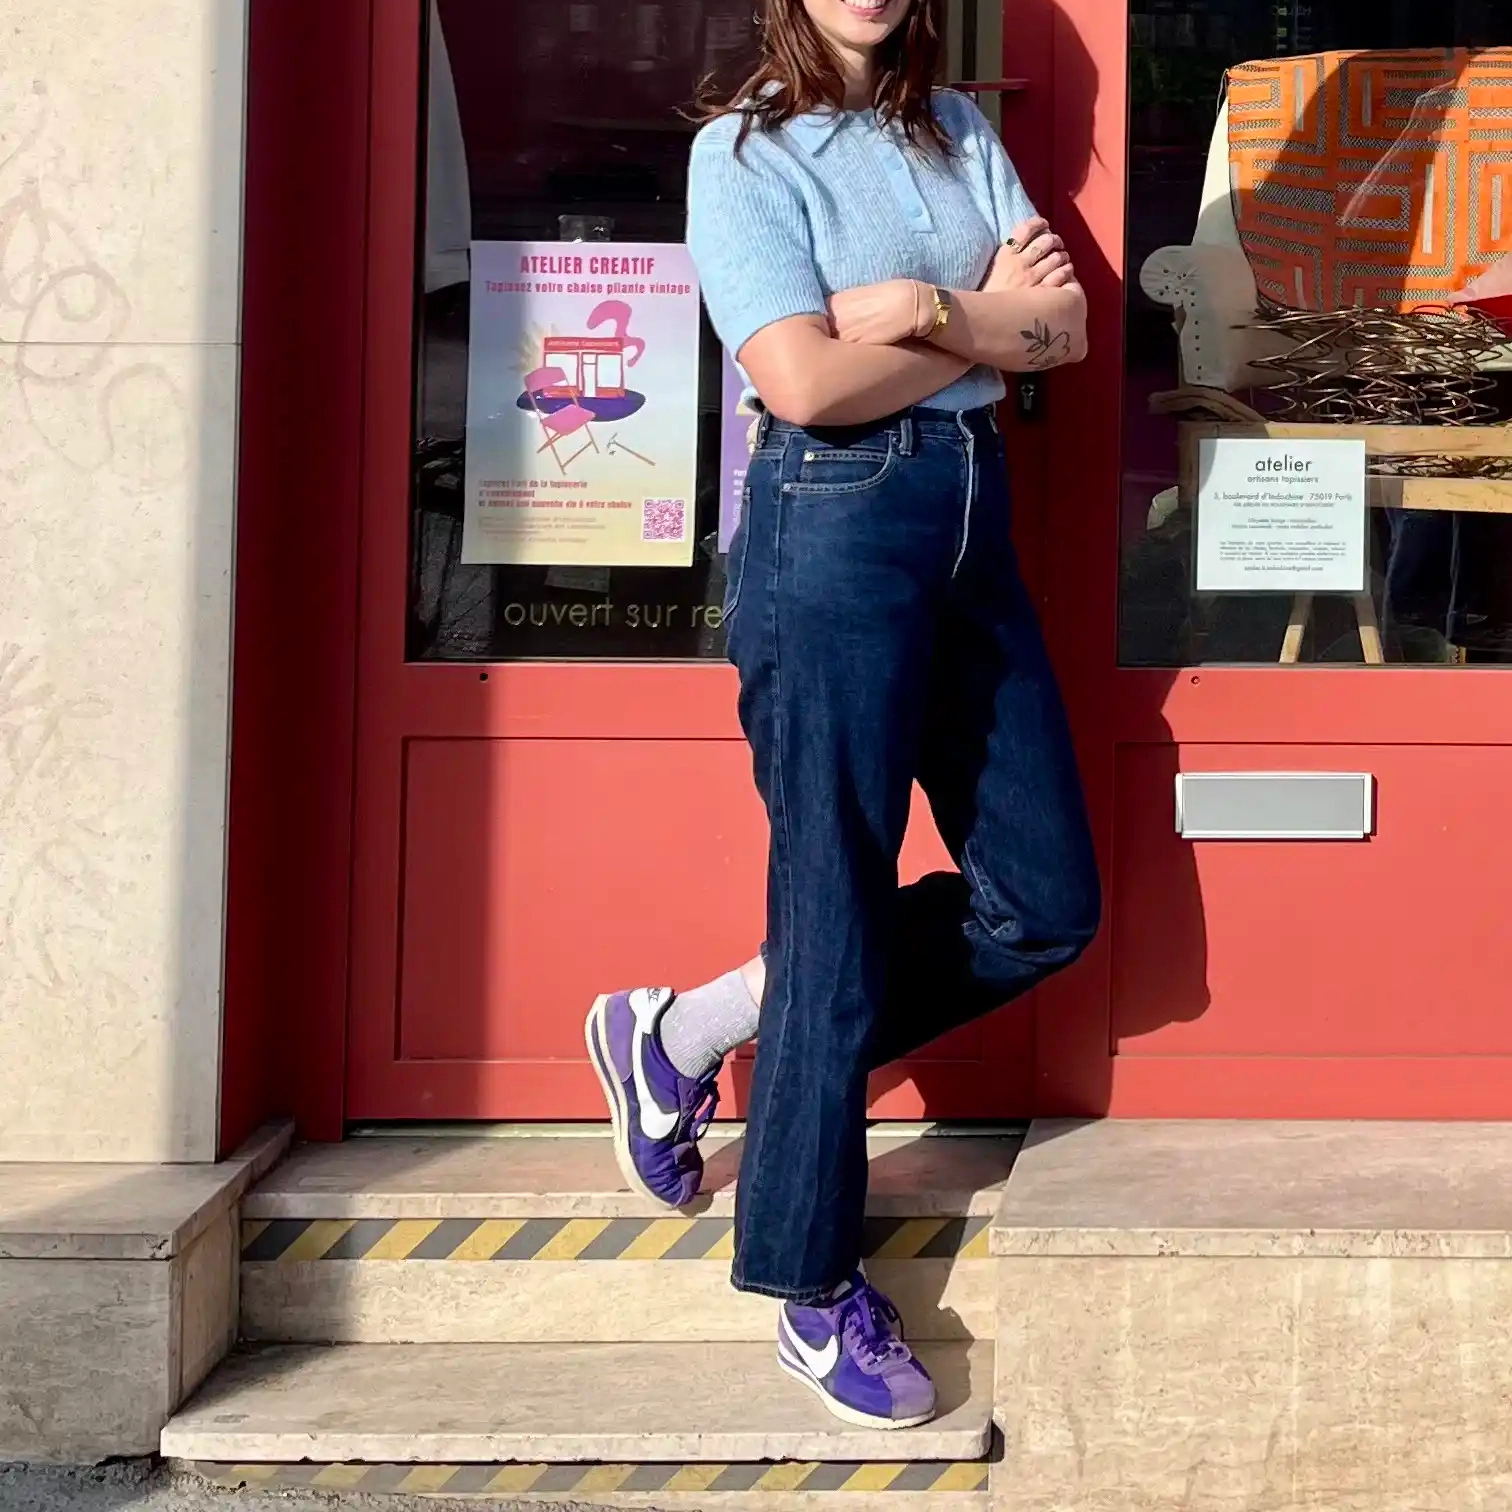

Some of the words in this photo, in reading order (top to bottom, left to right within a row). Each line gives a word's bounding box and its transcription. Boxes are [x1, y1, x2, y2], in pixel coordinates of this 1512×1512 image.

[520, 256, 583, 274] ATELIER
[589, 256, 655, 275] CREATIF
[535, 280, 563, 293] votre
[567, 281, 603, 294] chaise
[649, 282, 691, 296] vintage
[1254, 453, 1313, 472] atelier
[503, 596, 614, 627] ouvert
[624, 603, 678, 628] sur
